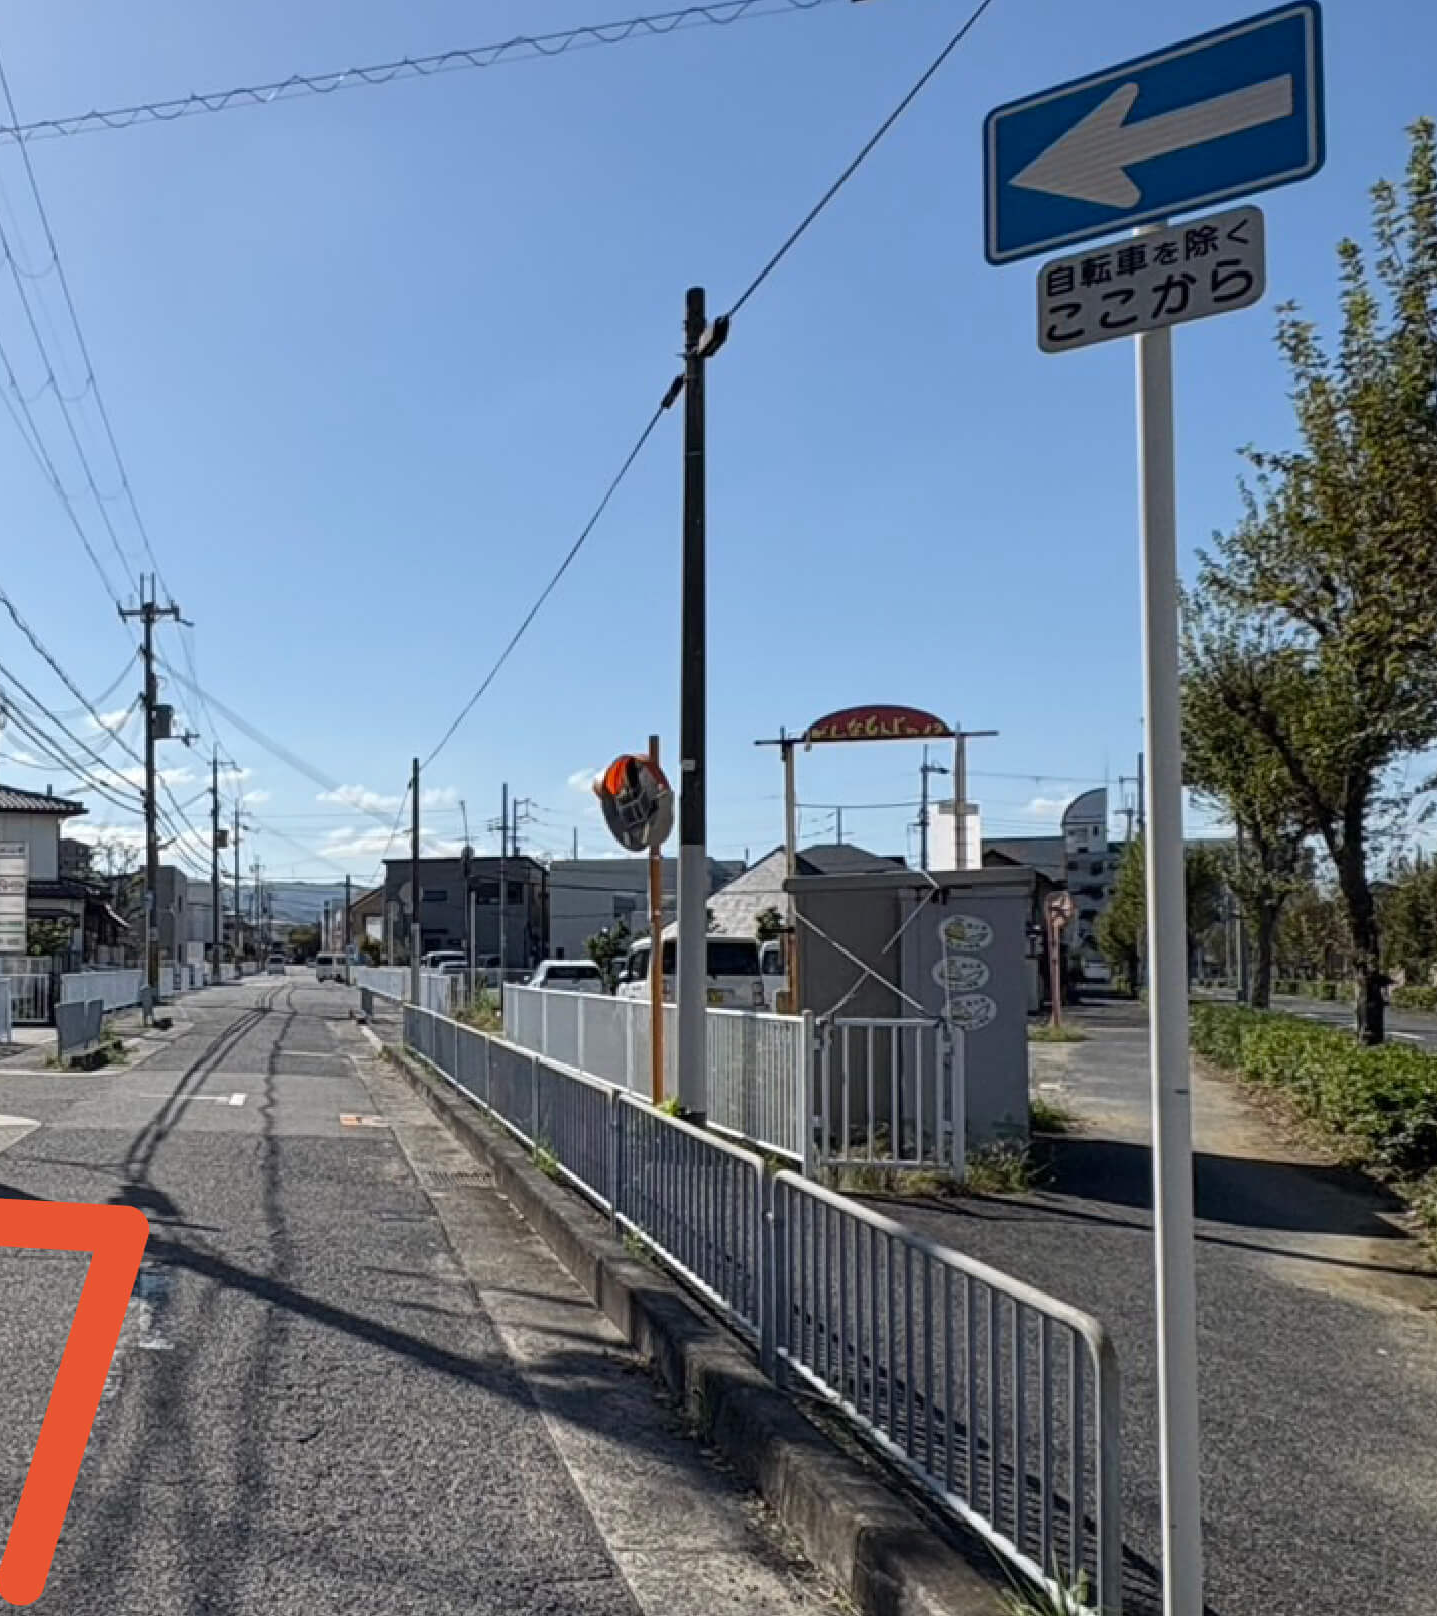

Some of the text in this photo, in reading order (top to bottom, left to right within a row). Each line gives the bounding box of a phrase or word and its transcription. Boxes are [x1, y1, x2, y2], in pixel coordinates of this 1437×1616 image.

[1046, 219, 1249, 297] 自転車を除く
[1046, 258, 1253, 342] ここから
